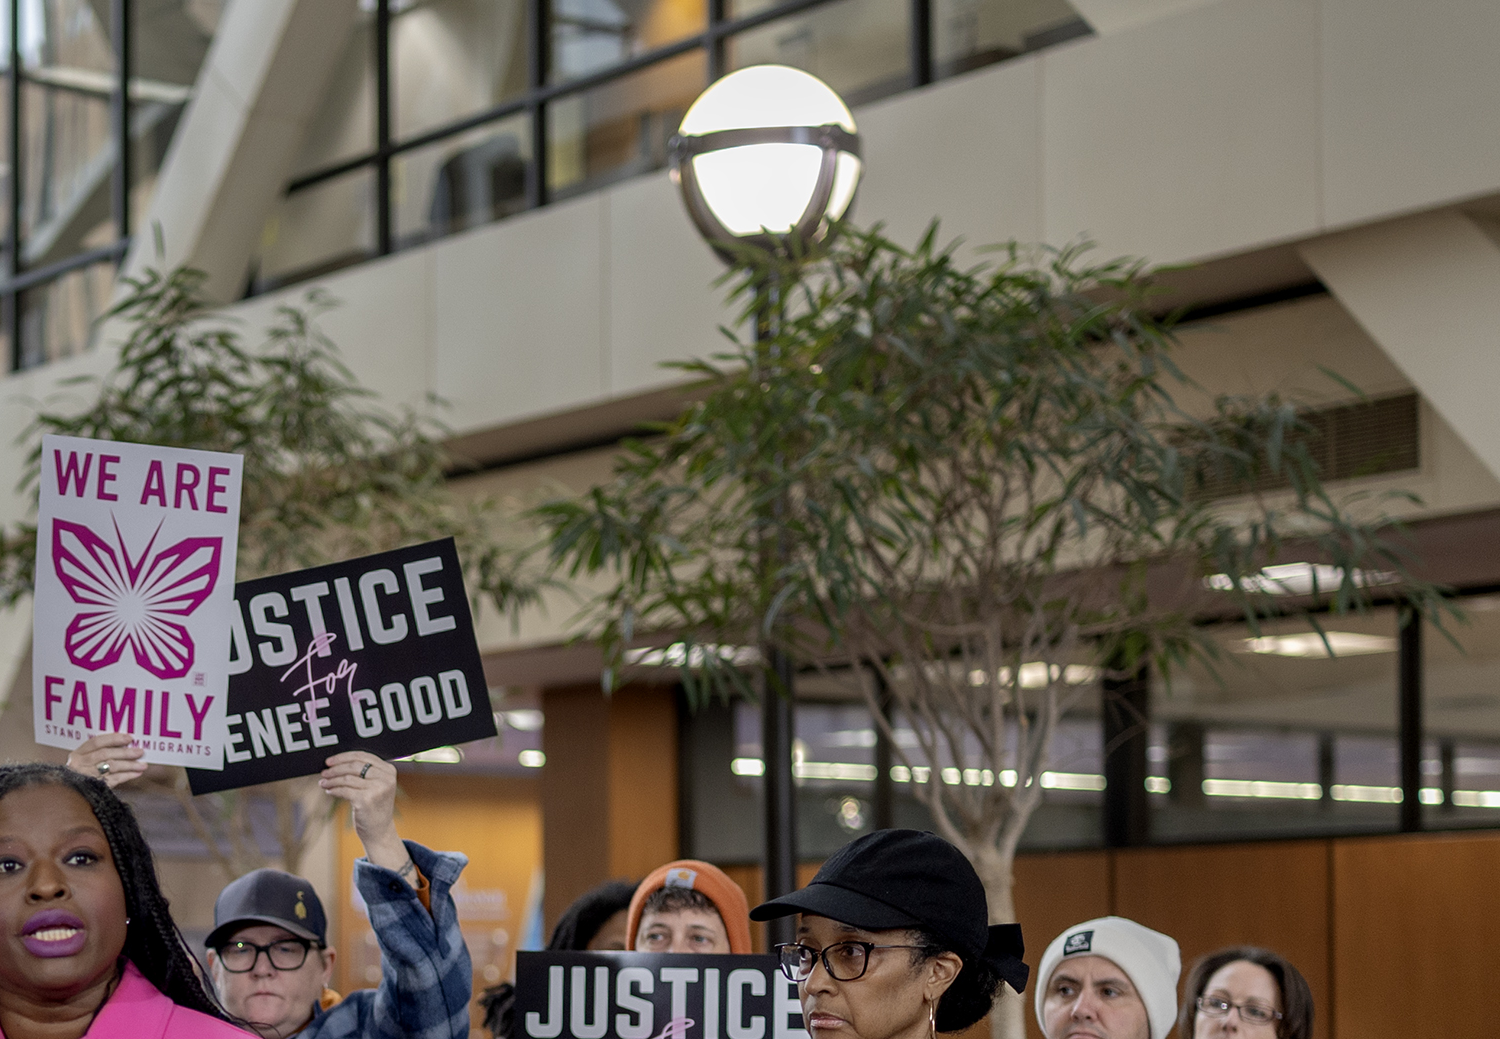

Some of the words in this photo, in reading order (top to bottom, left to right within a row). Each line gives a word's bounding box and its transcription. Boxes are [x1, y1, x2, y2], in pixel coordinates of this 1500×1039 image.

[54, 449, 120, 501] WE
[140, 460, 230, 513] ARE
[228, 556, 457, 675] USTICE
[44, 675, 215, 740] FAMILY
[225, 697, 339, 763] ENEE
[350, 668, 473, 738] GOOD
[45, 725, 81, 740] STAND
[124, 739, 212, 757] MMIGRANTS
